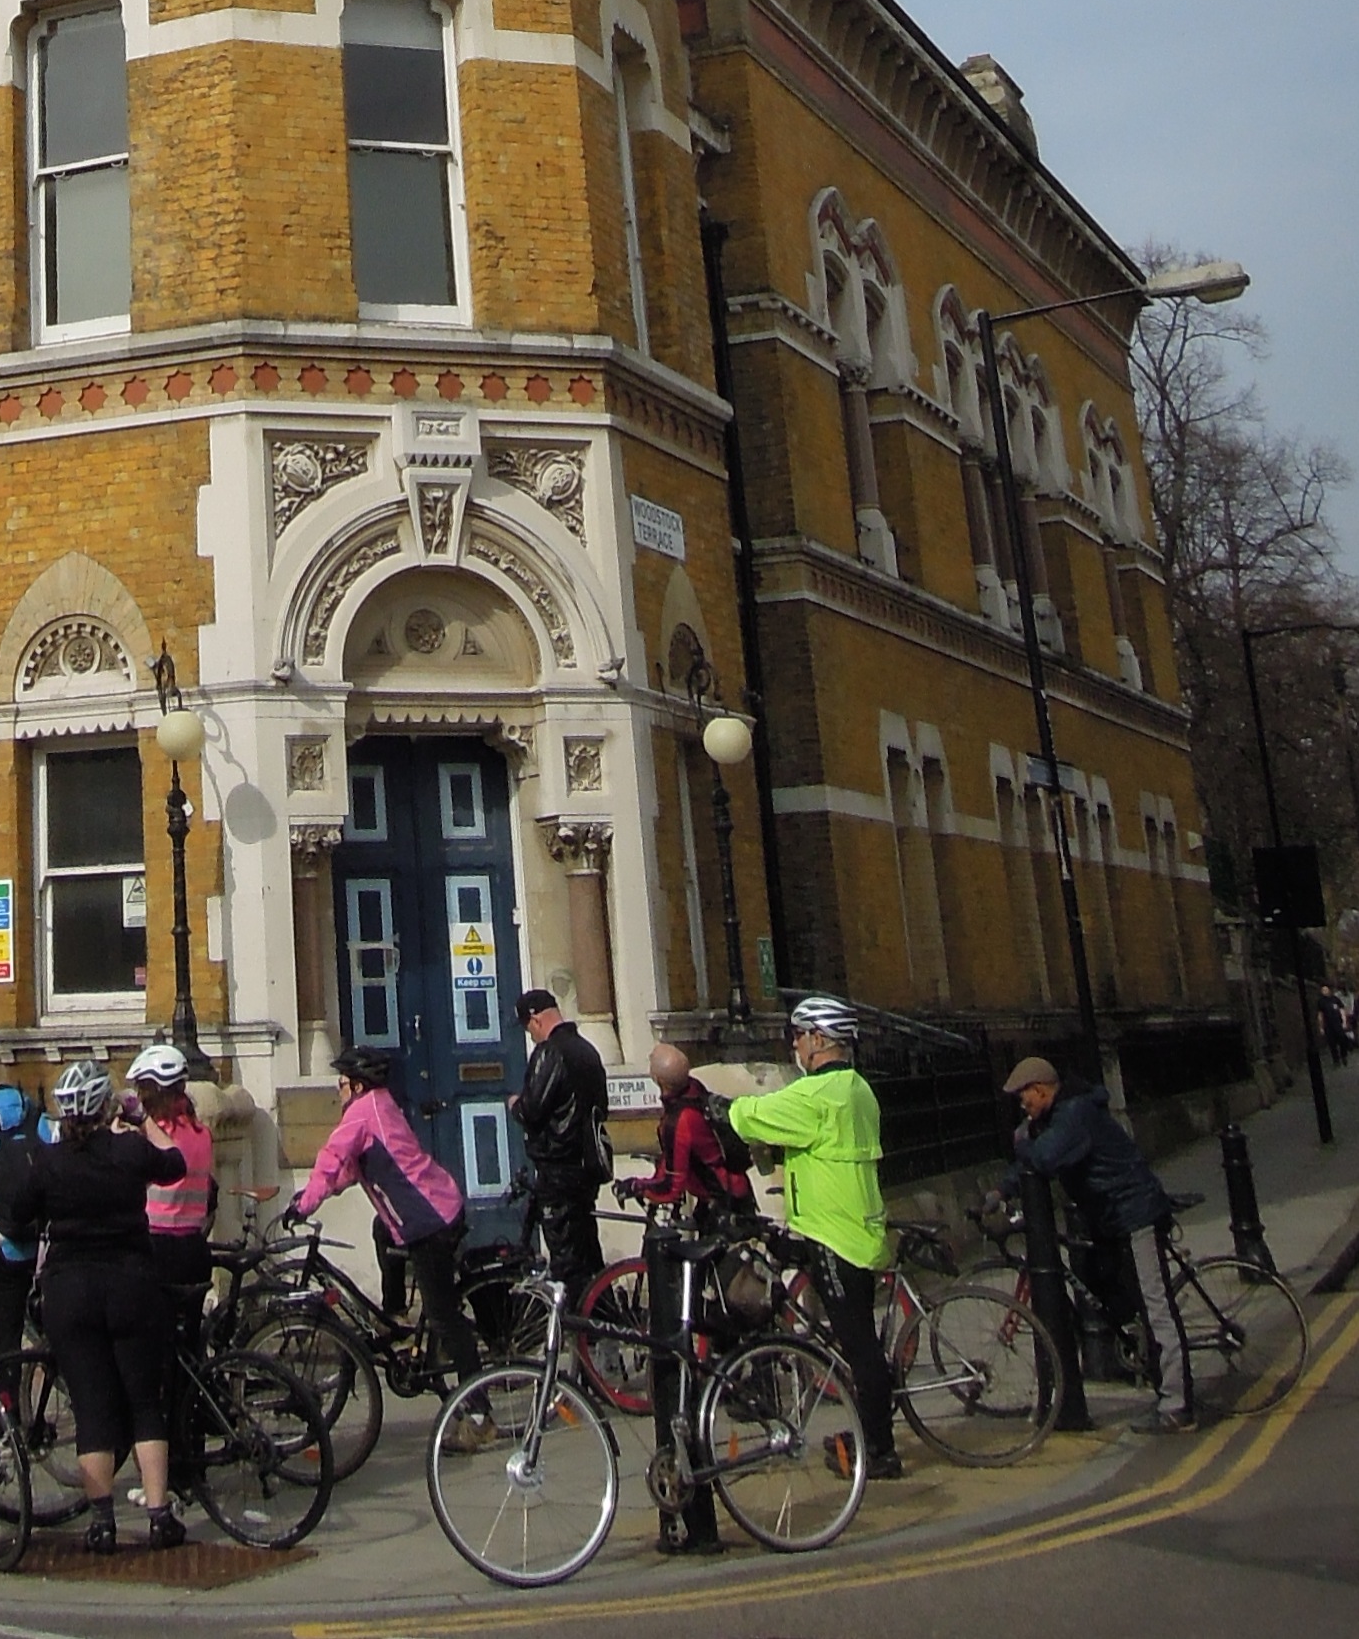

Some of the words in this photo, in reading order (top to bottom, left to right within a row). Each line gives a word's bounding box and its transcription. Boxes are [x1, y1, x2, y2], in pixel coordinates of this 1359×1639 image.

[634, 500, 681, 533] WOODSTOCK
[638, 521, 673, 550] TERRACE
[457, 979, 479, 987] Keep
[480, 978, 493, 986] out
[619, 1081, 645, 1092] POPLAR
[609, 1095, 621, 1106] IGH
[622, 1095, 631, 1105] ST
